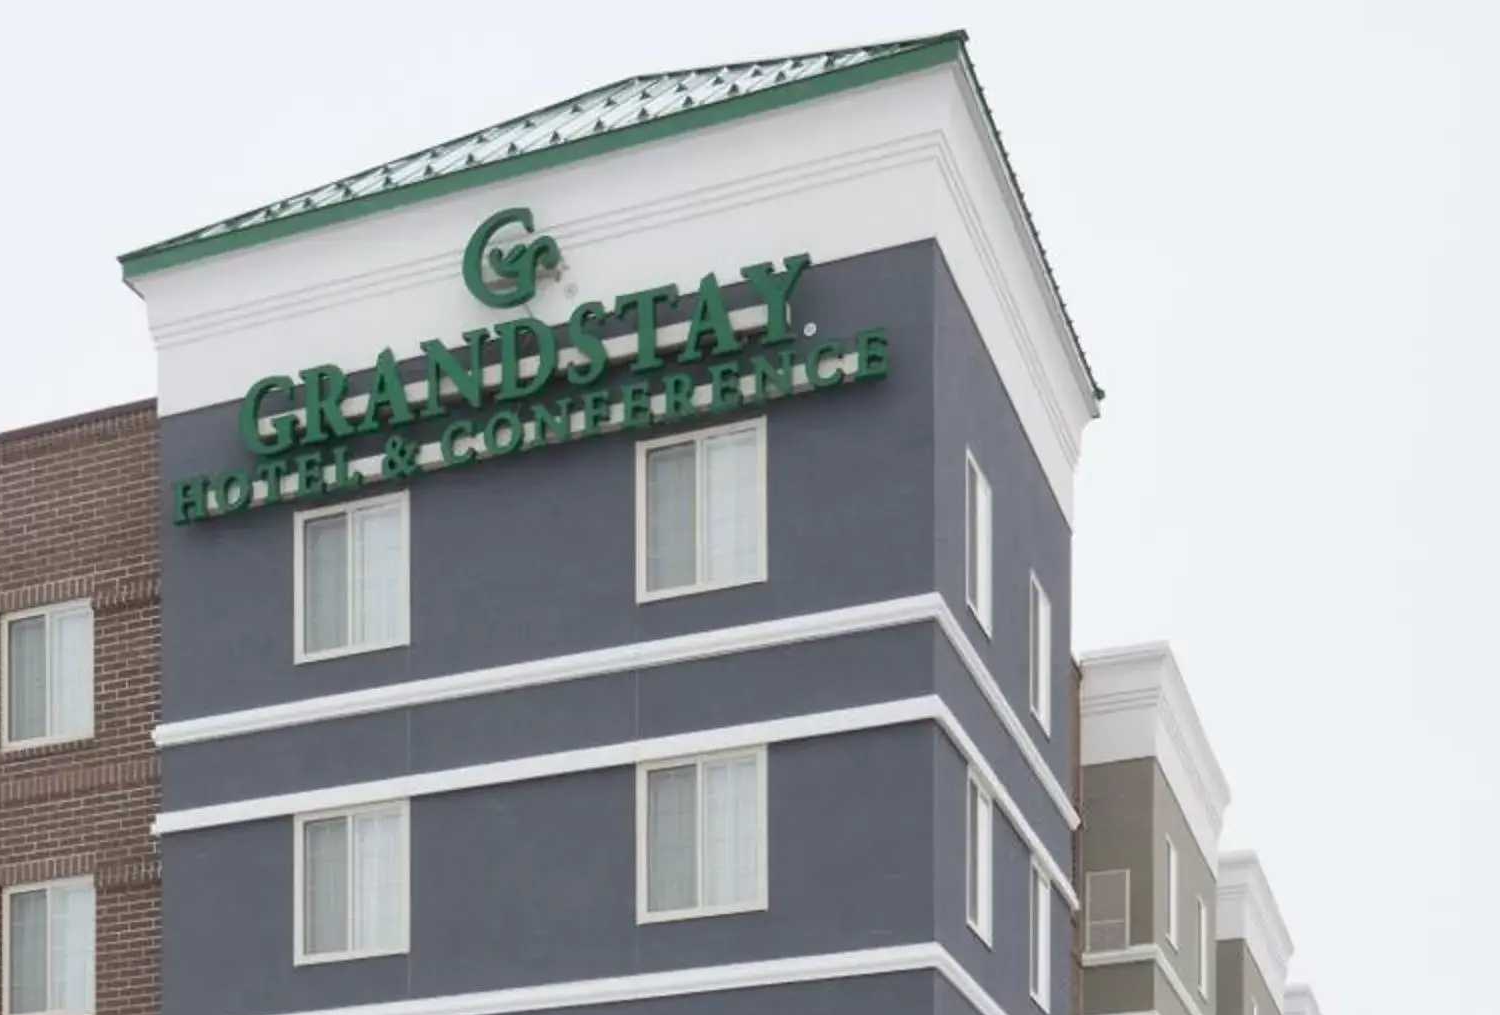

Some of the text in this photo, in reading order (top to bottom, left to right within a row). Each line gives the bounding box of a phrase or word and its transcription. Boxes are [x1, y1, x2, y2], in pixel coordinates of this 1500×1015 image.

[172, 327, 891, 525] HOTEL & CONFERENCE
[238, 253, 811, 456] GRANDSTAY
